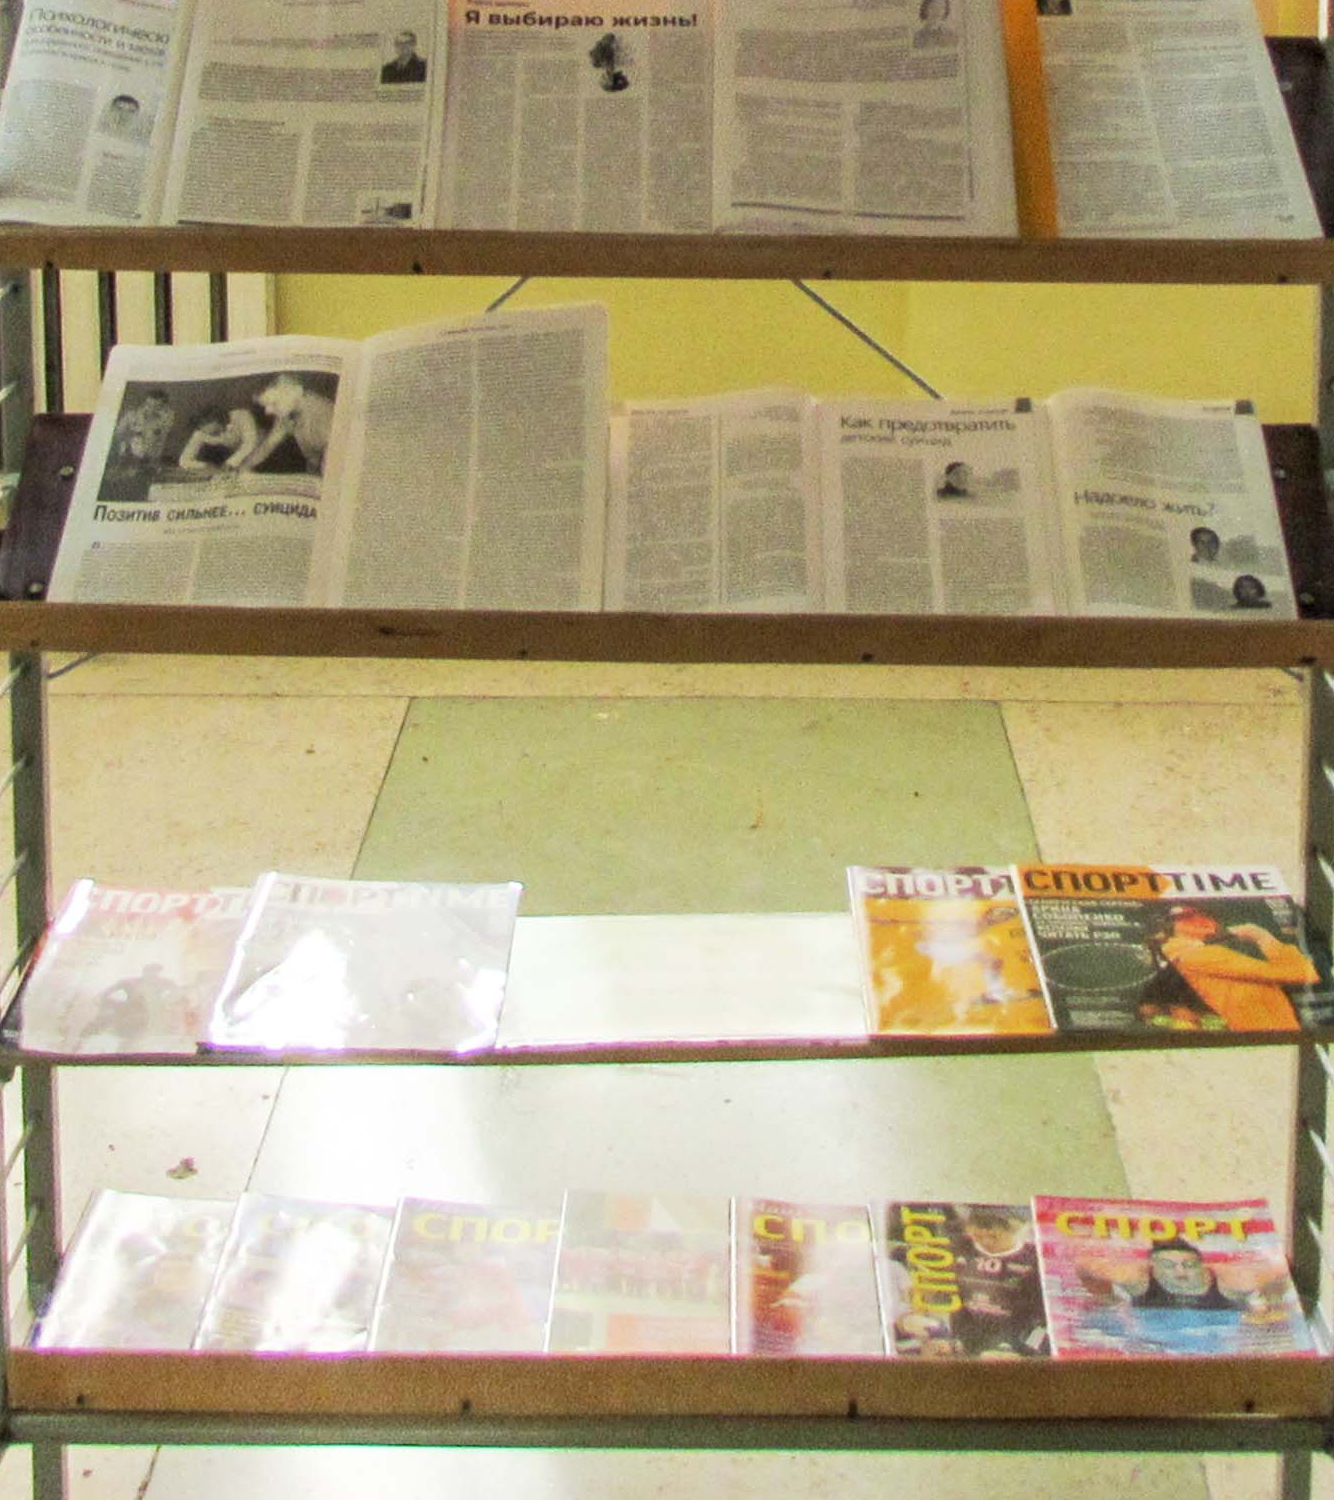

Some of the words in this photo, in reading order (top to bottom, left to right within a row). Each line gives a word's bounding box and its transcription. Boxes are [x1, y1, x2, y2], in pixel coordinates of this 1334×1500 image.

[465, 10, 479, 24] Я
[489, 11, 604, 29] выбираю
[612, 13, 698, 28] жизнь!
[841, 415, 873, 429] Как
[879, 417, 1016, 434] предотвратить
[1054, 1210, 1253, 1242] СПОРТ
[900, 1205, 964, 1314] СПОРТ
